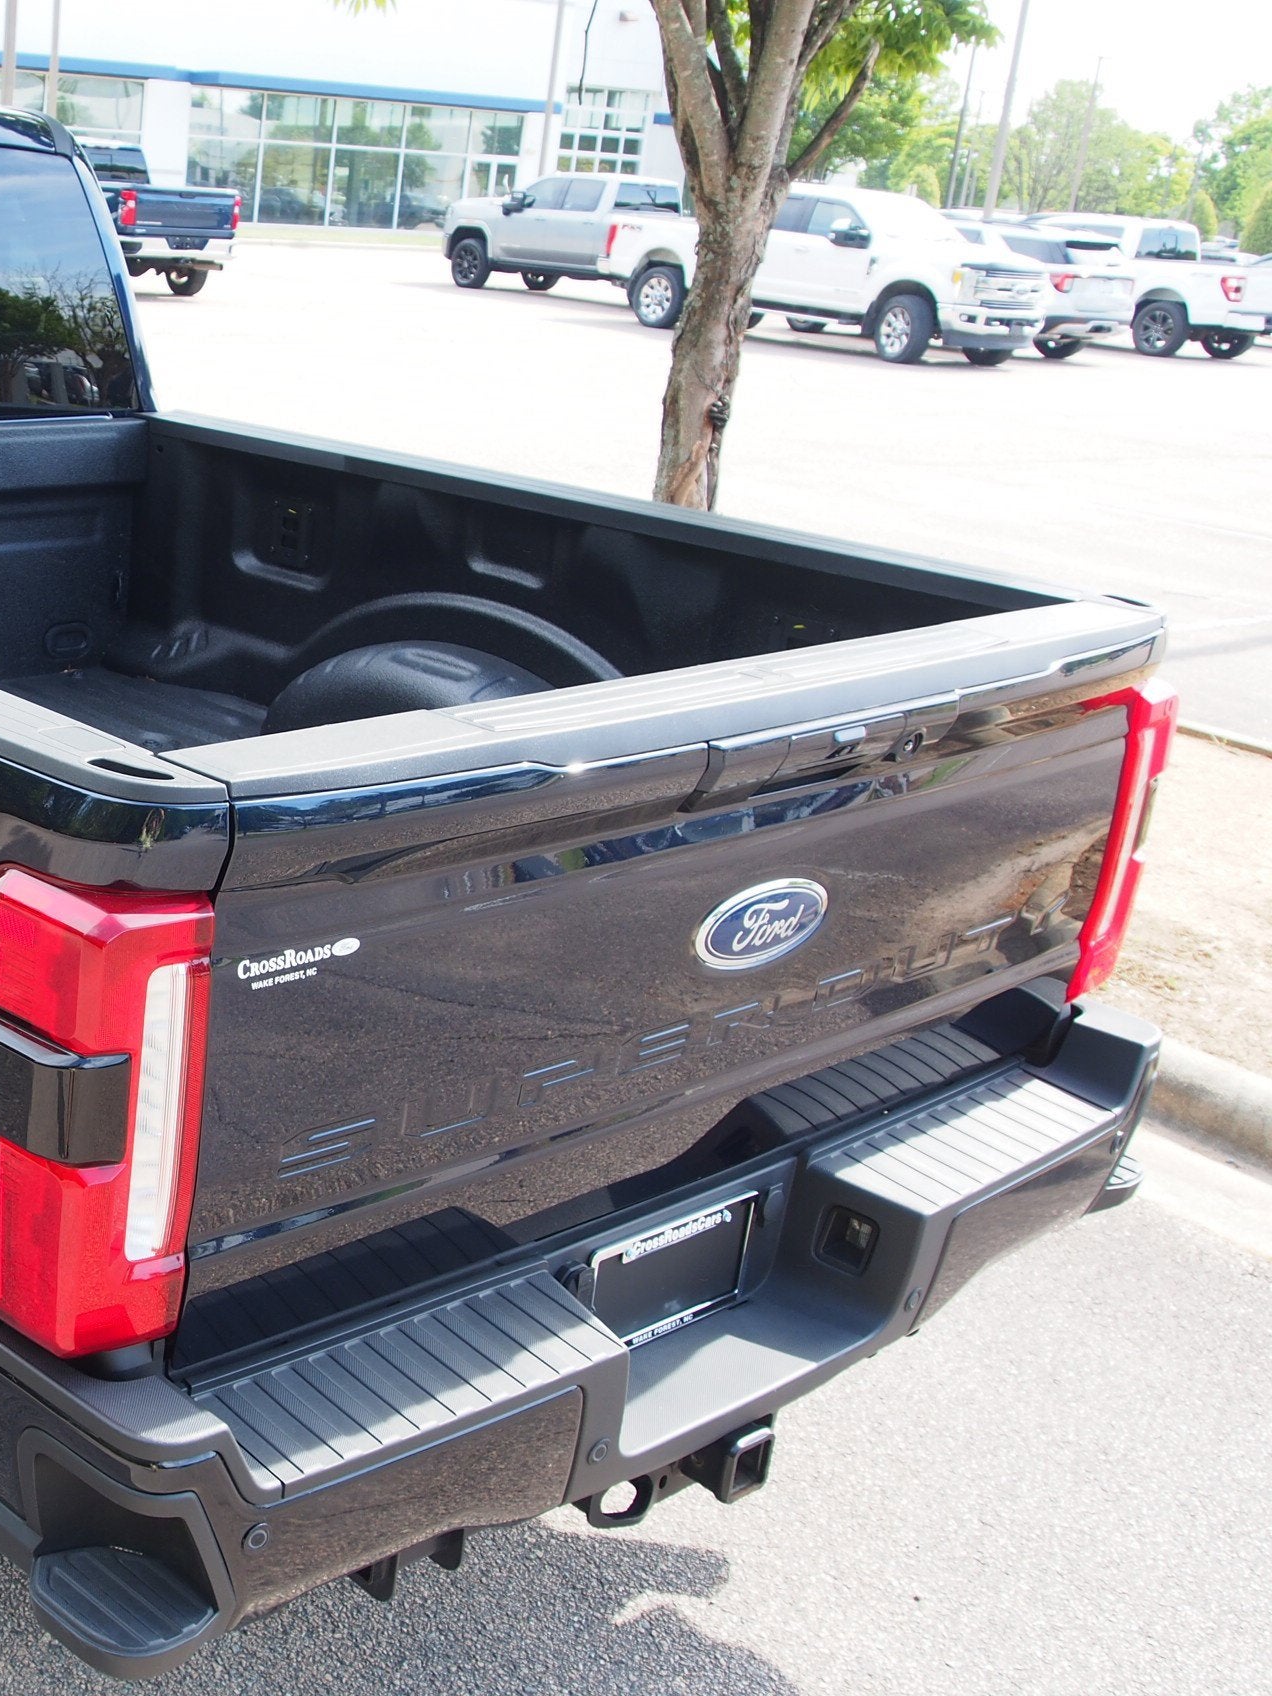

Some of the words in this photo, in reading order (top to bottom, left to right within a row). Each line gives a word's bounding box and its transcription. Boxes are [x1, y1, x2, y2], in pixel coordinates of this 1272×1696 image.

[732, 899, 805, 952] Ford
[251, 978, 274, 991] WAKE
[306, 967, 318, 977] NC
[277, 994, 782, 1179] SUPER
[811, 890, 1073, 1012] DUTY
[632, 1330, 653, 1345] WAKE
[683, 1313, 694, 1323] NC
